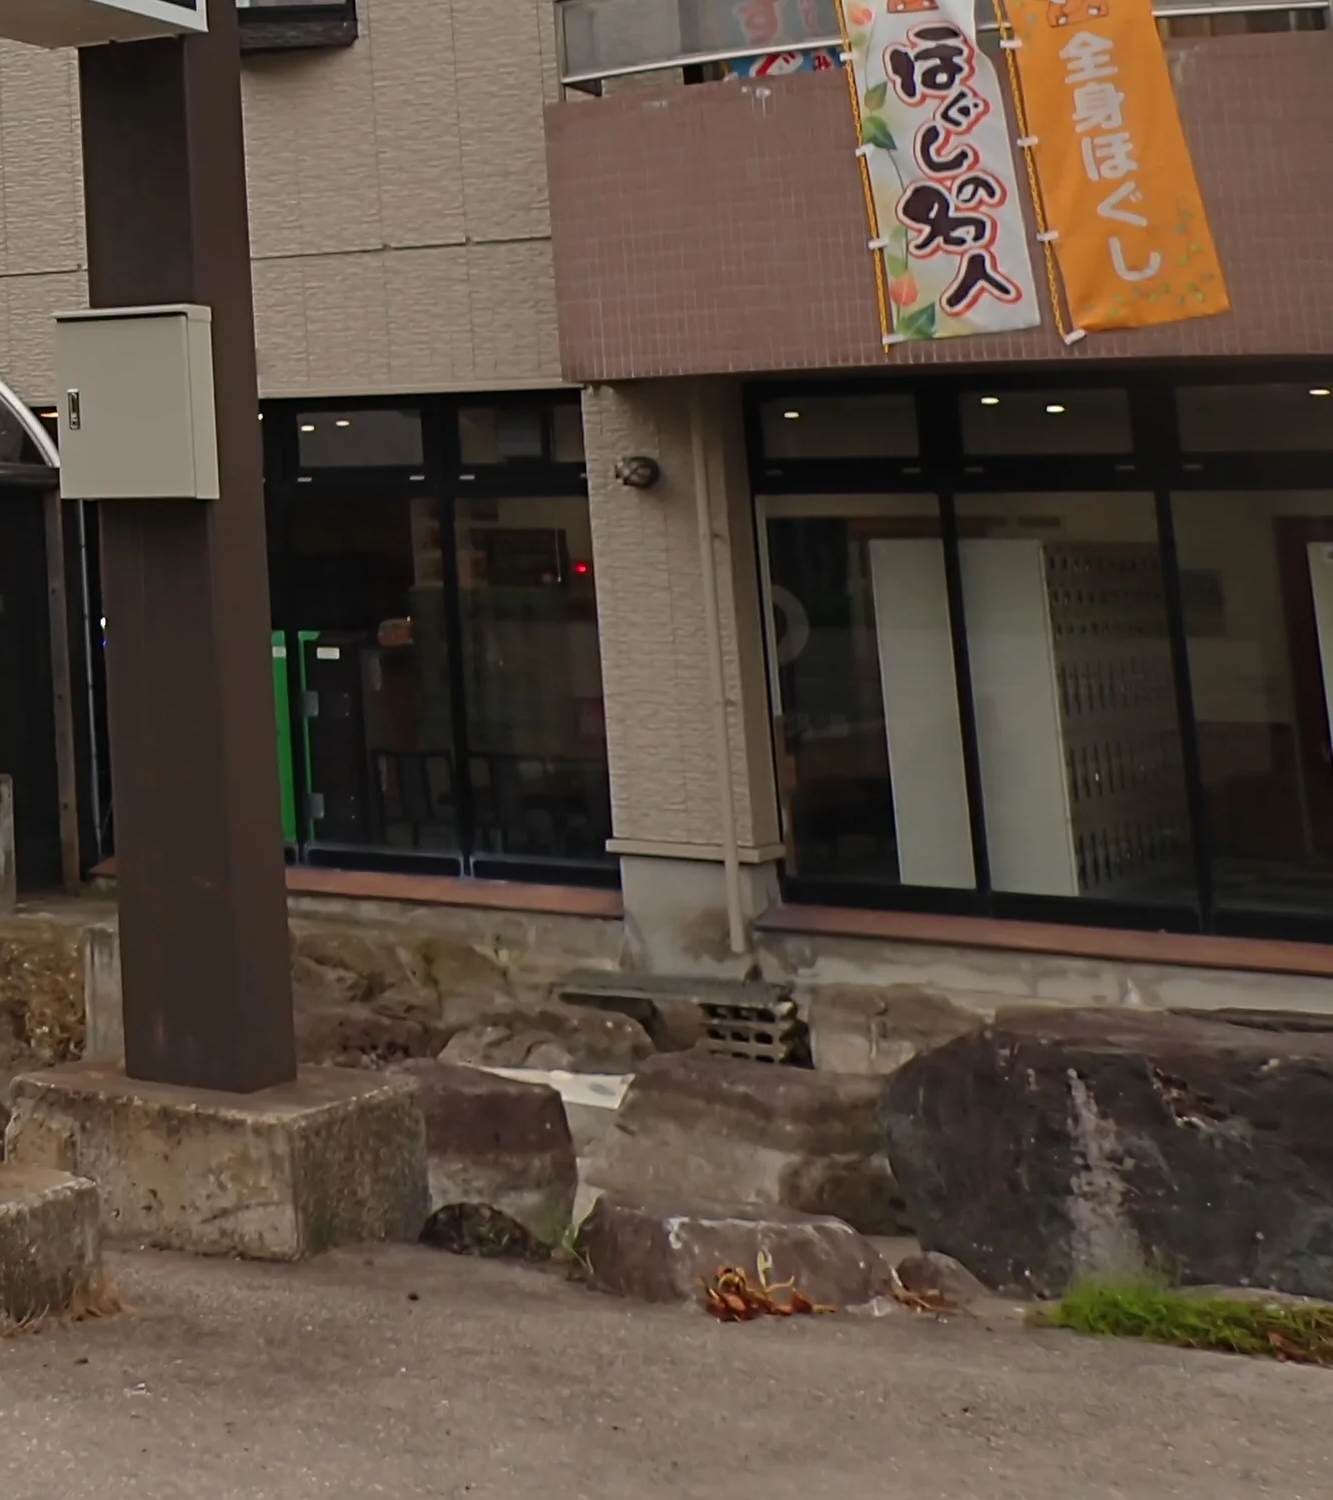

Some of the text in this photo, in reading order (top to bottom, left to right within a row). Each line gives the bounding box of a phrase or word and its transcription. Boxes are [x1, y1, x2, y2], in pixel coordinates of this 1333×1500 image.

[884, 23, 1020, 314] ほぐしの名人
[1059, 31, 1162, 282] 全身ほぐし
